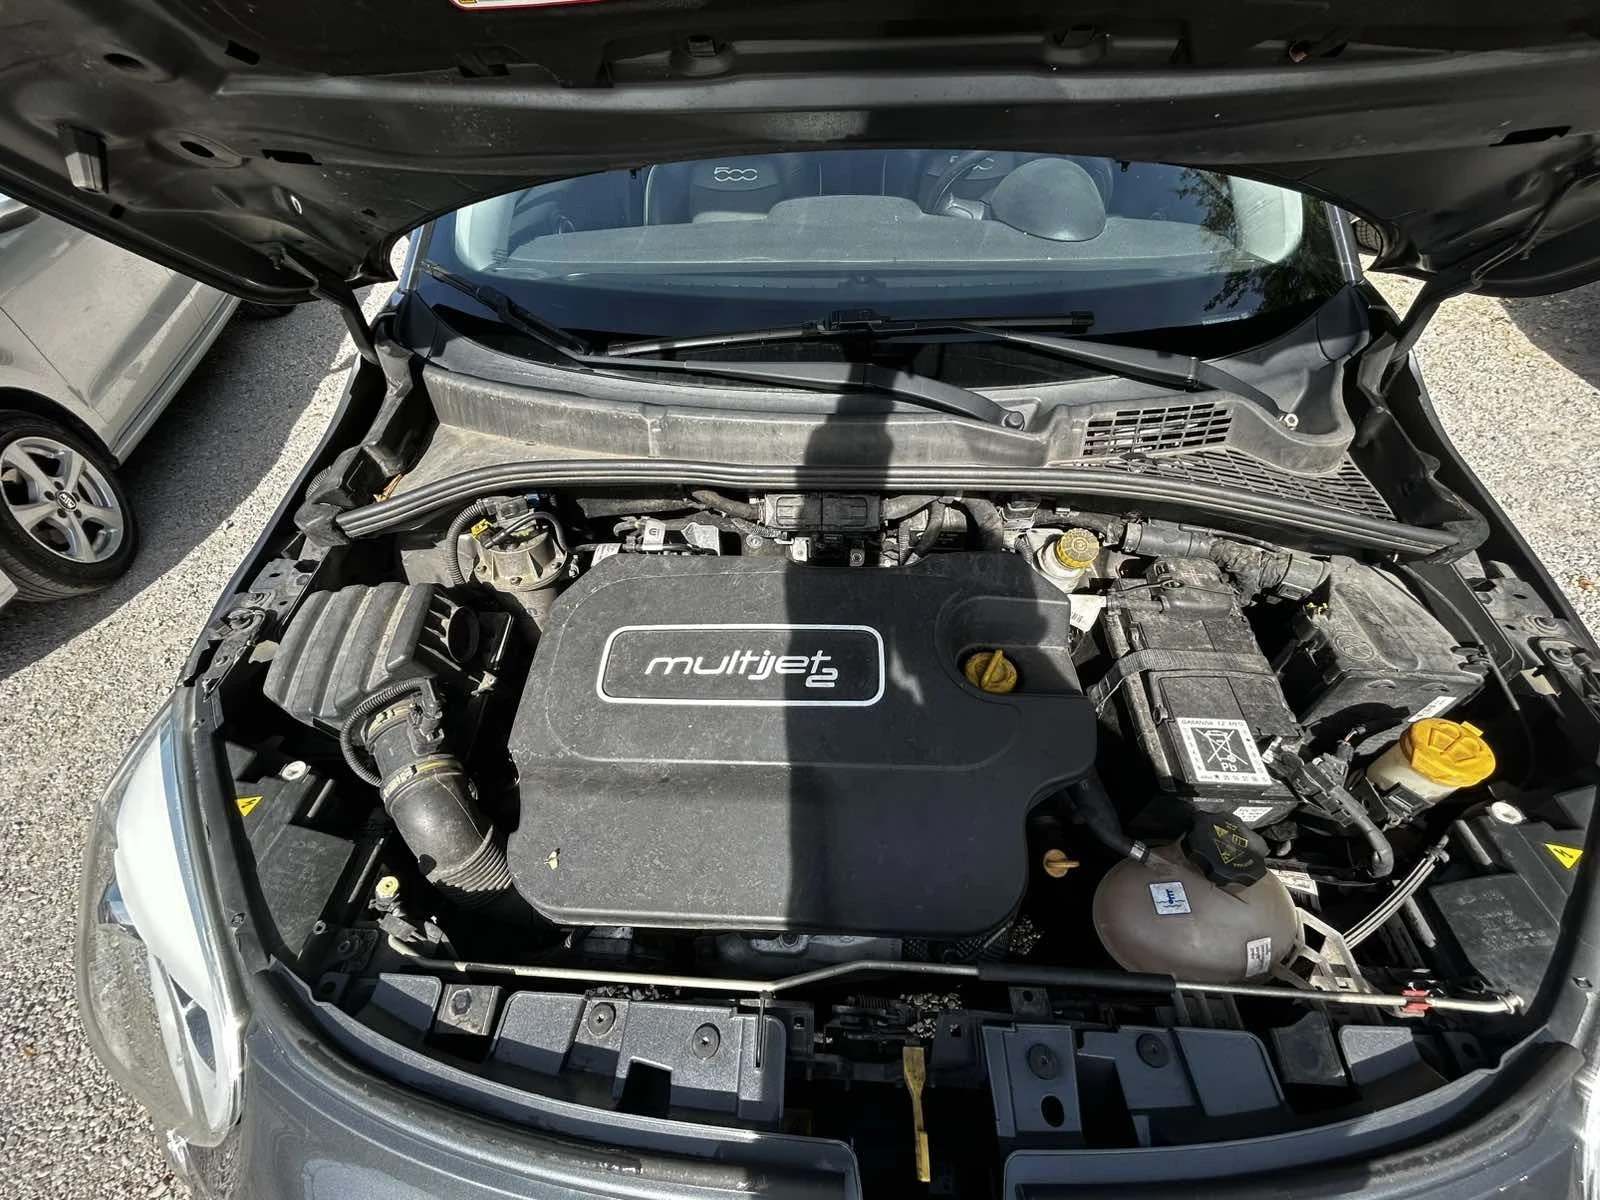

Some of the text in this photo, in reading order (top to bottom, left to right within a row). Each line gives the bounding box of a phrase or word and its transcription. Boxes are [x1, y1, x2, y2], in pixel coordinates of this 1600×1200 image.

[714, 166, 758, 181] 500
[645, 650, 831, 680] multijet
[1221, 761, 1238, 772] Pb
